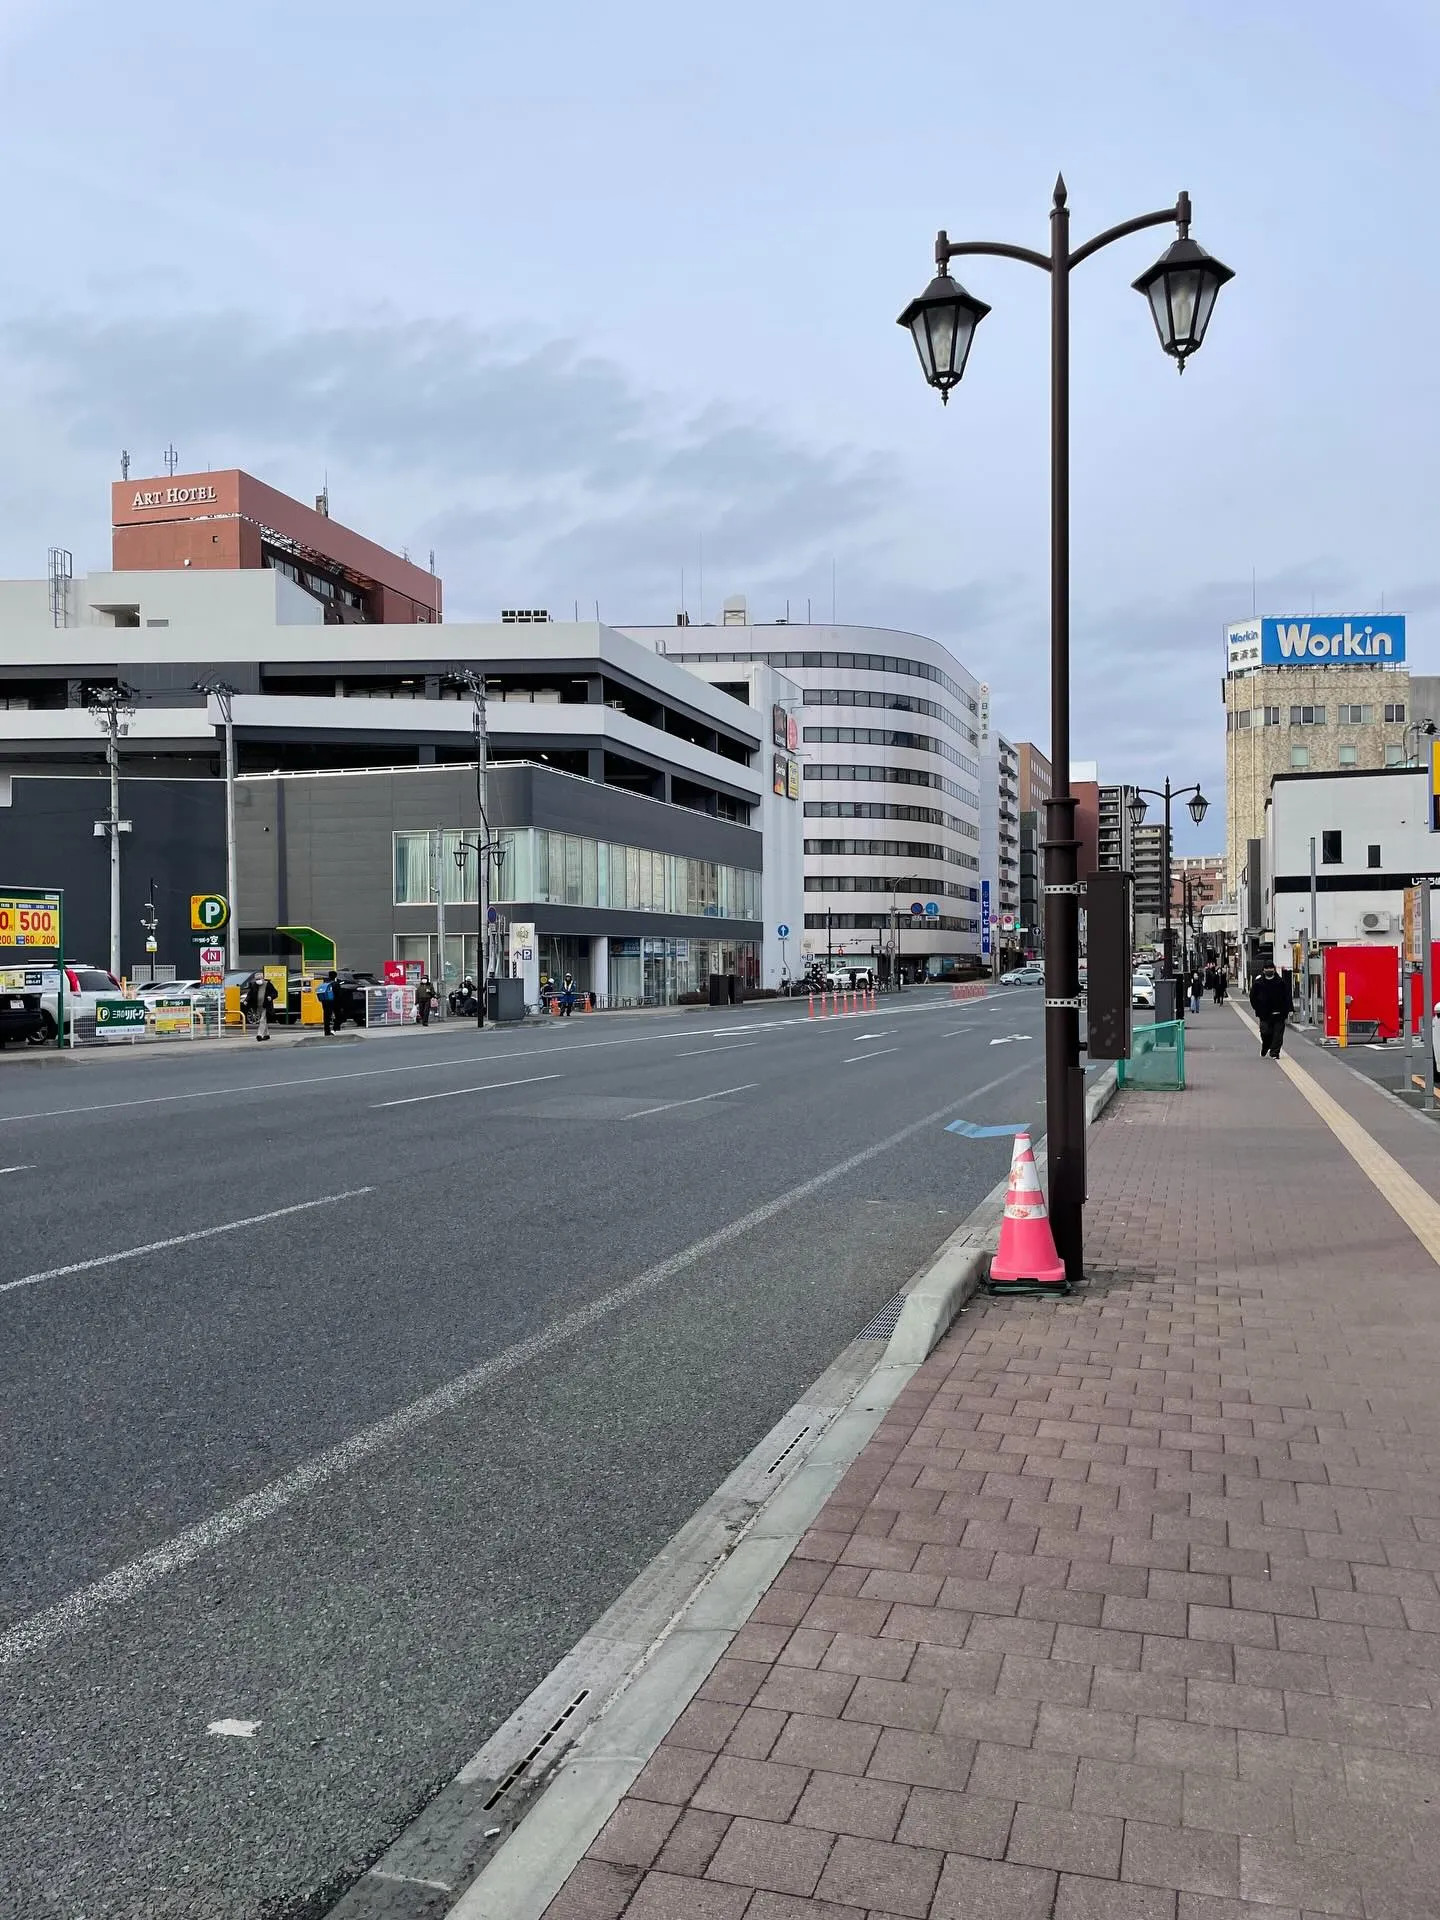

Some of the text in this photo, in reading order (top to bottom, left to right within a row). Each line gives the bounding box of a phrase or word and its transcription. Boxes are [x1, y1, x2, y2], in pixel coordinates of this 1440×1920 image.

[132, 486, 216, 506] ART HOTEL
[1230, 630, 1258, 644] Workin
[1276, 623, 1393, 657] Workin
[20, 911, 51, 931] 500
[205, 901, 220, 924] P
[207, 952, 217, 960] IN
[112, 1008, 144, 1020] 三井のリパーク
